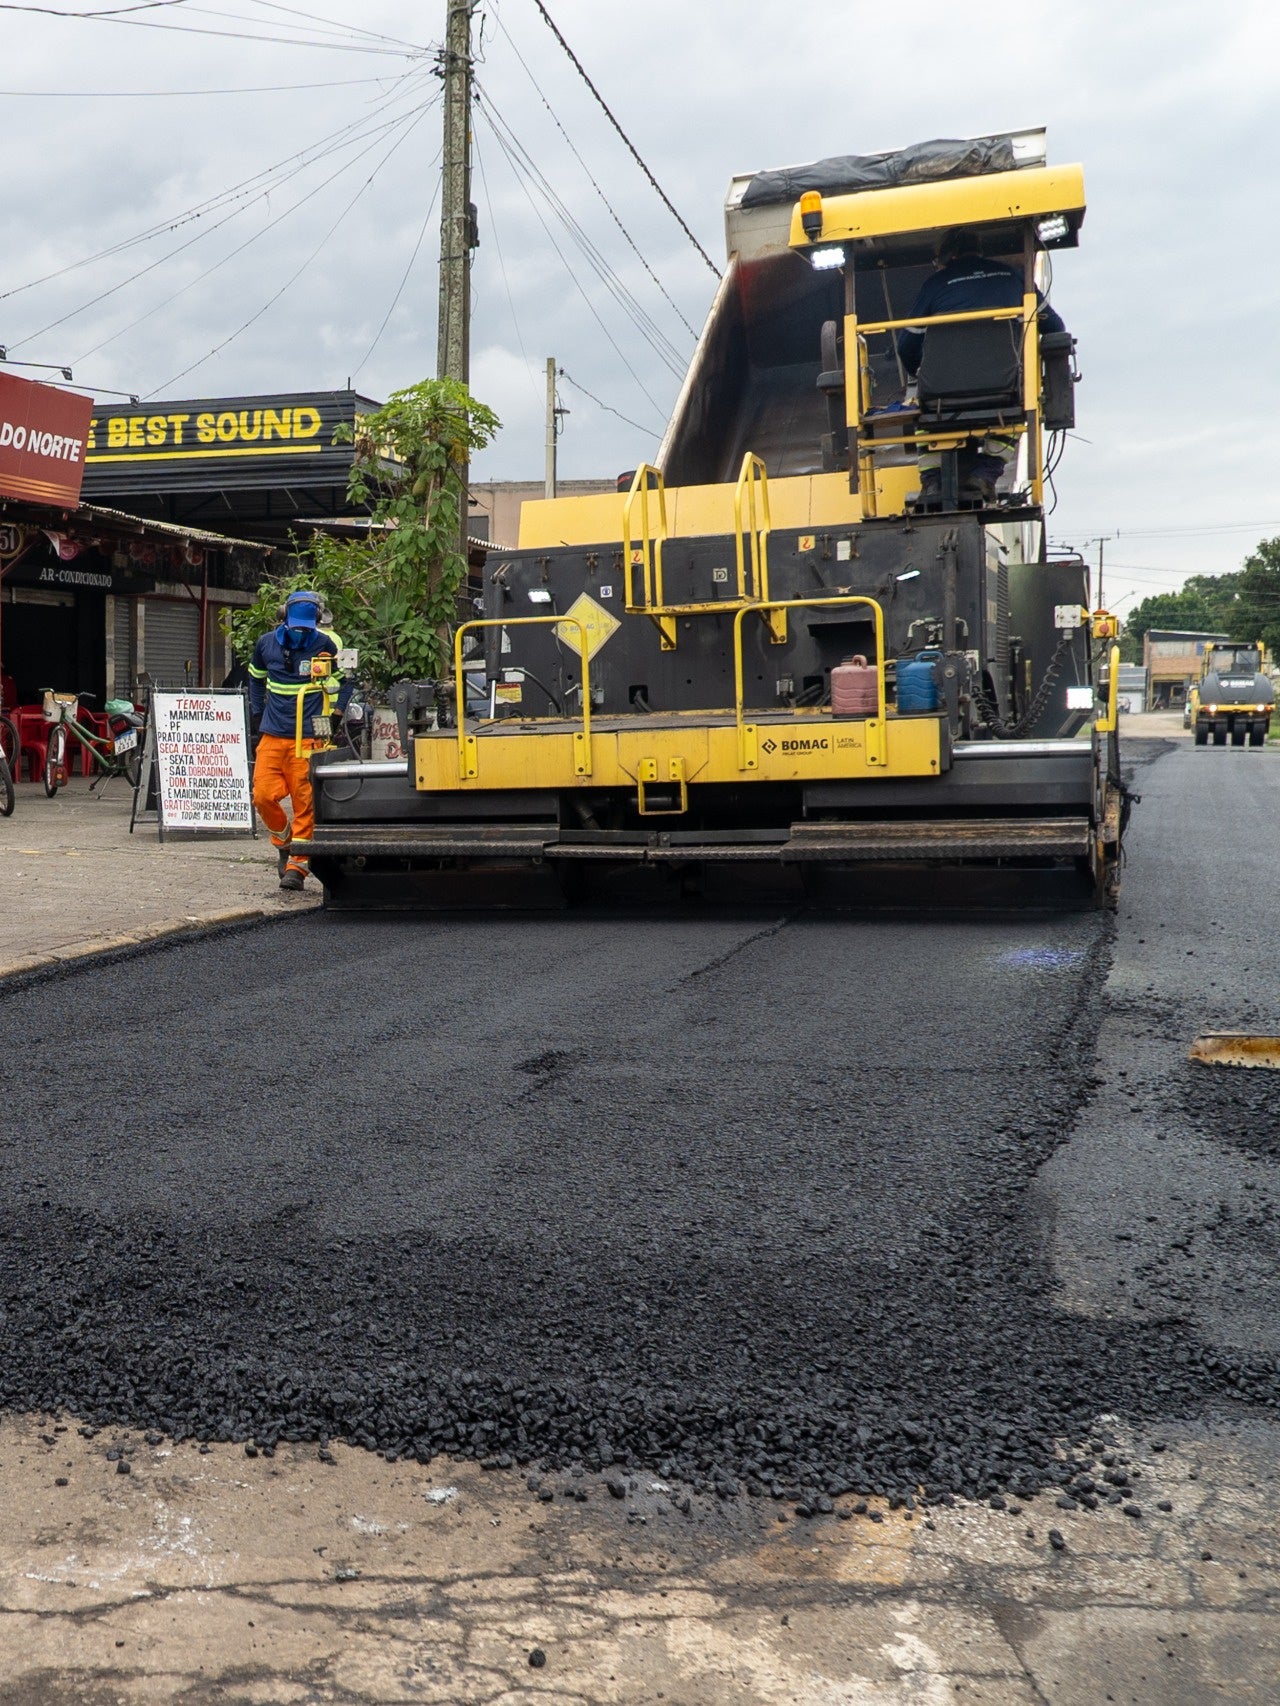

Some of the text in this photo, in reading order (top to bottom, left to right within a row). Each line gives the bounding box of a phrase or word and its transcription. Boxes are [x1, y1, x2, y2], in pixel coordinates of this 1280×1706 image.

[107, 414, 190, 448] BEST
[196, 407, 322, 443] SOUND
[0, 422, 27, 450] DO
[27, 429, 83, 463] NORTE
[0, 527, 15, 550] 51
[39, 568, 112, 587] AR-CONDICIONADO
[170, 710, 215, 721] MARMITAS
[170, 722, 181, 731] PF
[158, 731, 181, 742] PRATO
[183, 732, 193, 743] DA
[217, 734, 240, 744] CARNE
[160, 743, 224, 754] SECA ACEBOLADA
[781, 739, 828, 751] BOMAG
[188, 778, 218, 788] FRANGO
[219, 778, 244, 788] ASSADO
[174, 788, 210, 799] MAIONESE
[212, 789, 241, 800] CASEIRA
[181, 811, 200, 820] TODAS
[204, 812, 211, 820] AS
[214, 812, 248, 821] MARMITAS
